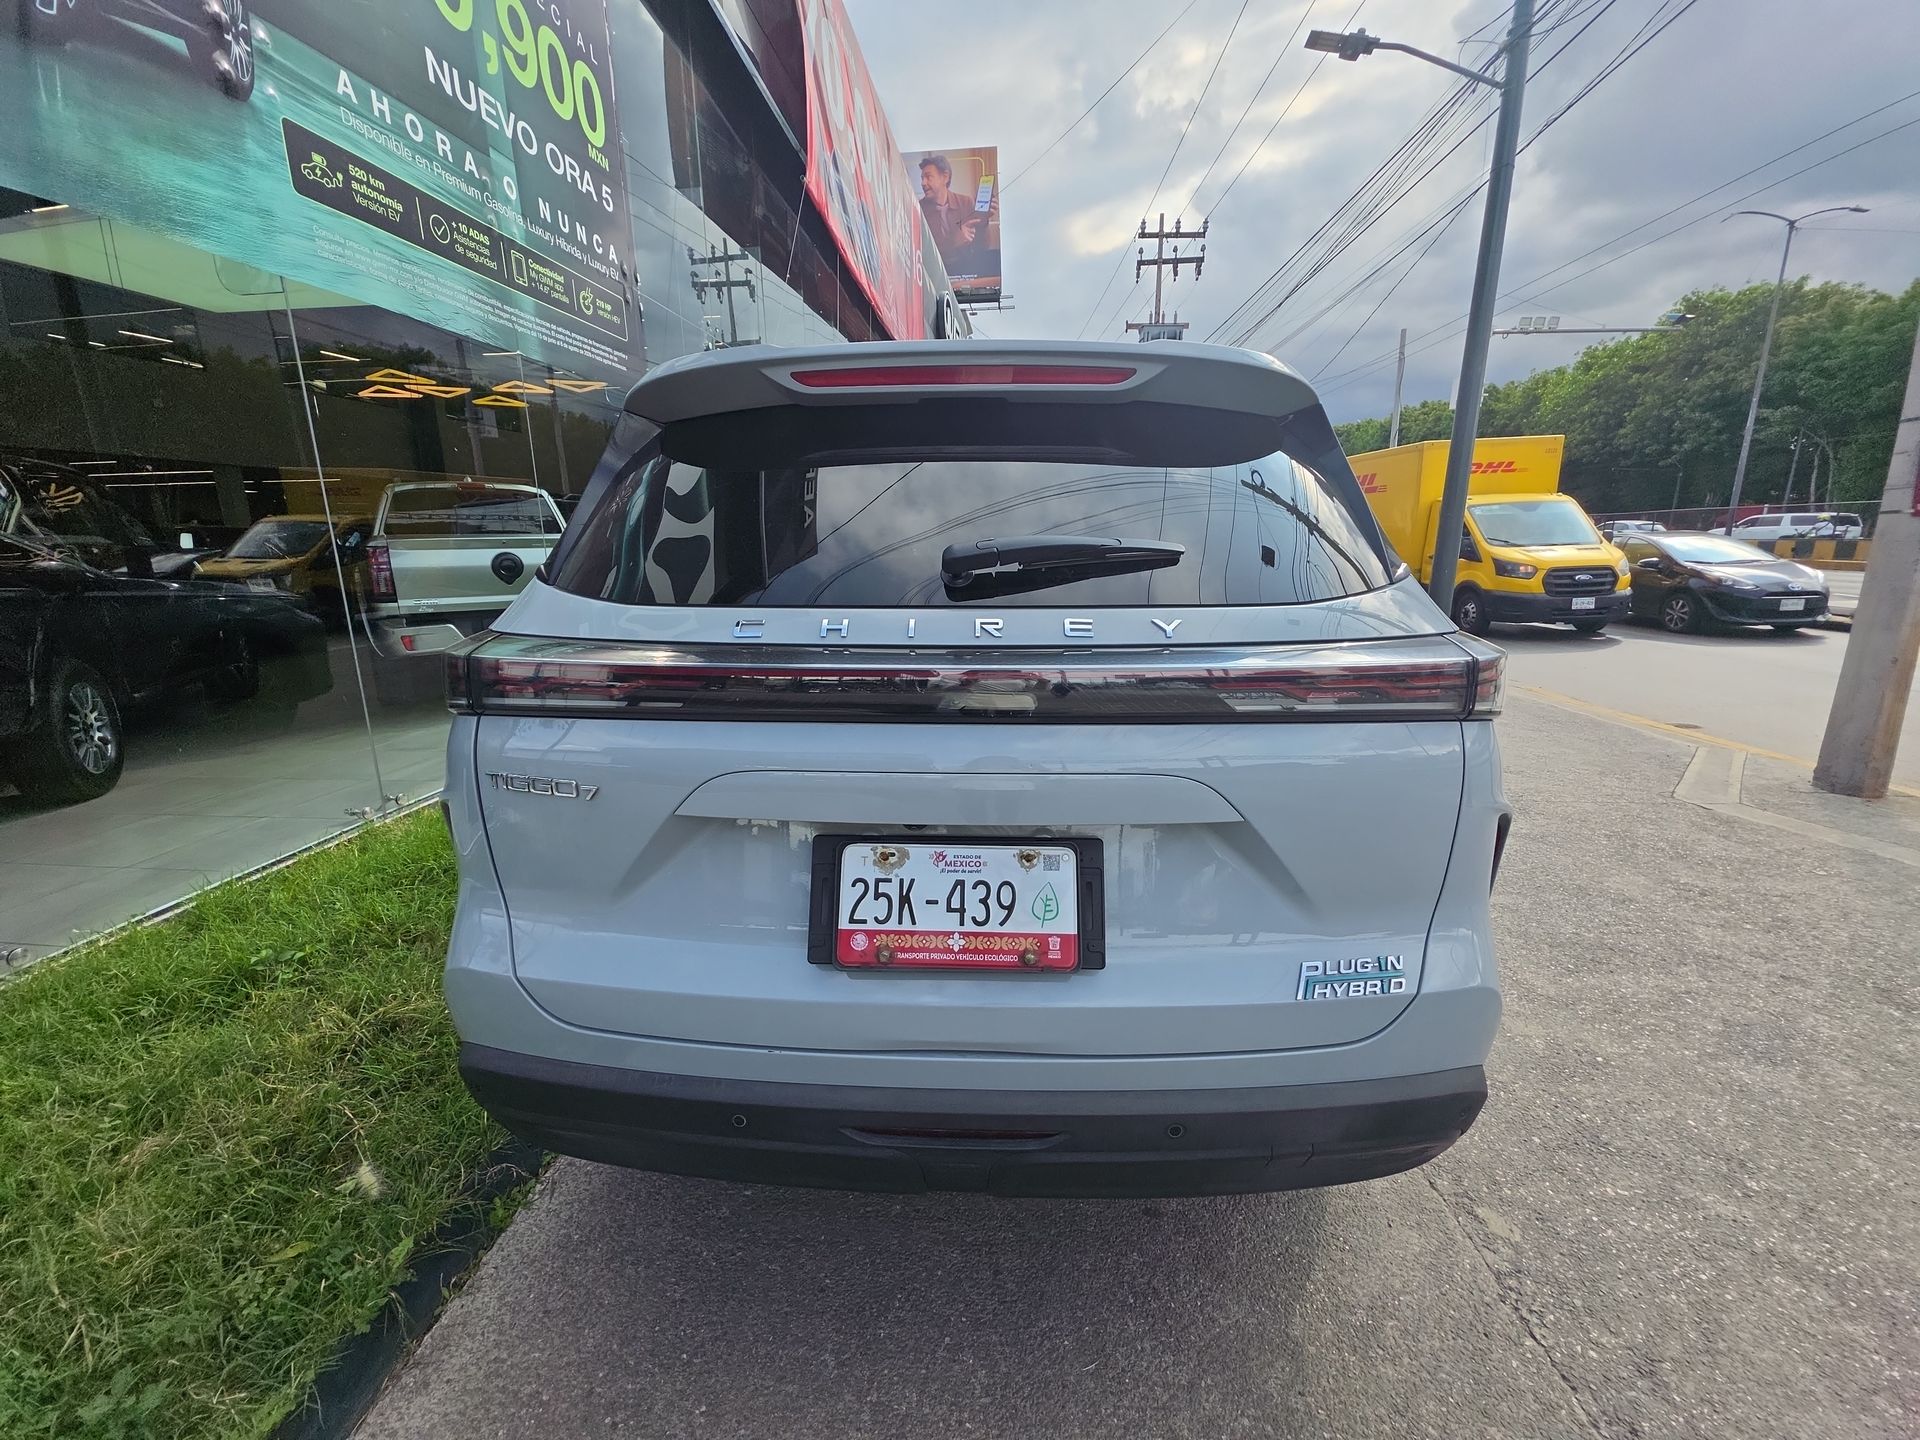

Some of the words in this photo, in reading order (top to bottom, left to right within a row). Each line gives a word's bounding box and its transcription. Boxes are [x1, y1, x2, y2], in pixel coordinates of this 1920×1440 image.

[424, 46, 537, 155] NUEVO
[546, 142, 598, 202] ORA
[602, 184, 614, 212] 5
[336, 69, 480, 179] AHORA
[503, 176, 517, 200] O
[538, 197, 619, 265] NUNCA
[588, 143, 609, 172] MXN
[348, 164, 367, 182] 520
[369, 174, 385, 191] km
[340, 106, 412, 161] Disponible
[415, 156, 431, 173] en
[433, 160, 482, 202] Premium
[483, 192, 526, 230] Gasolina,
[527, 217, 555, 245] Luxury
[582, 252, 588, 265] y
[588, 253, 610, 278] Luxury
[610, 267, 619, 281] EV
[351, 180, 403, 212] autonomía
[352, 191, 387, 217] Versión
[388, 210, 400, 222] EV
[451, 221, 457, 229] +
[458, 222, 468, 235] 10
[469, 227, 490, 245] ADAS
[453, 232, 490, 256] Asistencias
[454, 242, 465, 254] de
[466, 249, 497, 270] seguridad
[528, 258, 564, 283] Conectividad
[529, 269, 538, 281] My
[538, 273, 554, 287] GWM
[554, 282, 564, 292] app
[550, 291, 569, 304] pantalla
[1471, 461, 1518, 474] DHL
[732, 618, 1182, 638] CHIREY
[485, 772, 578, 798] TIGGO
[580, 785, 599, 801] 7
[848, 877, 1017, 927] 25K-439
[895, 952, 929, 960] TRANSPORTE
[956, 952, 984, 961] VEHÍCULO
[985, 952, 1018, 962] ECOLÓGICO
